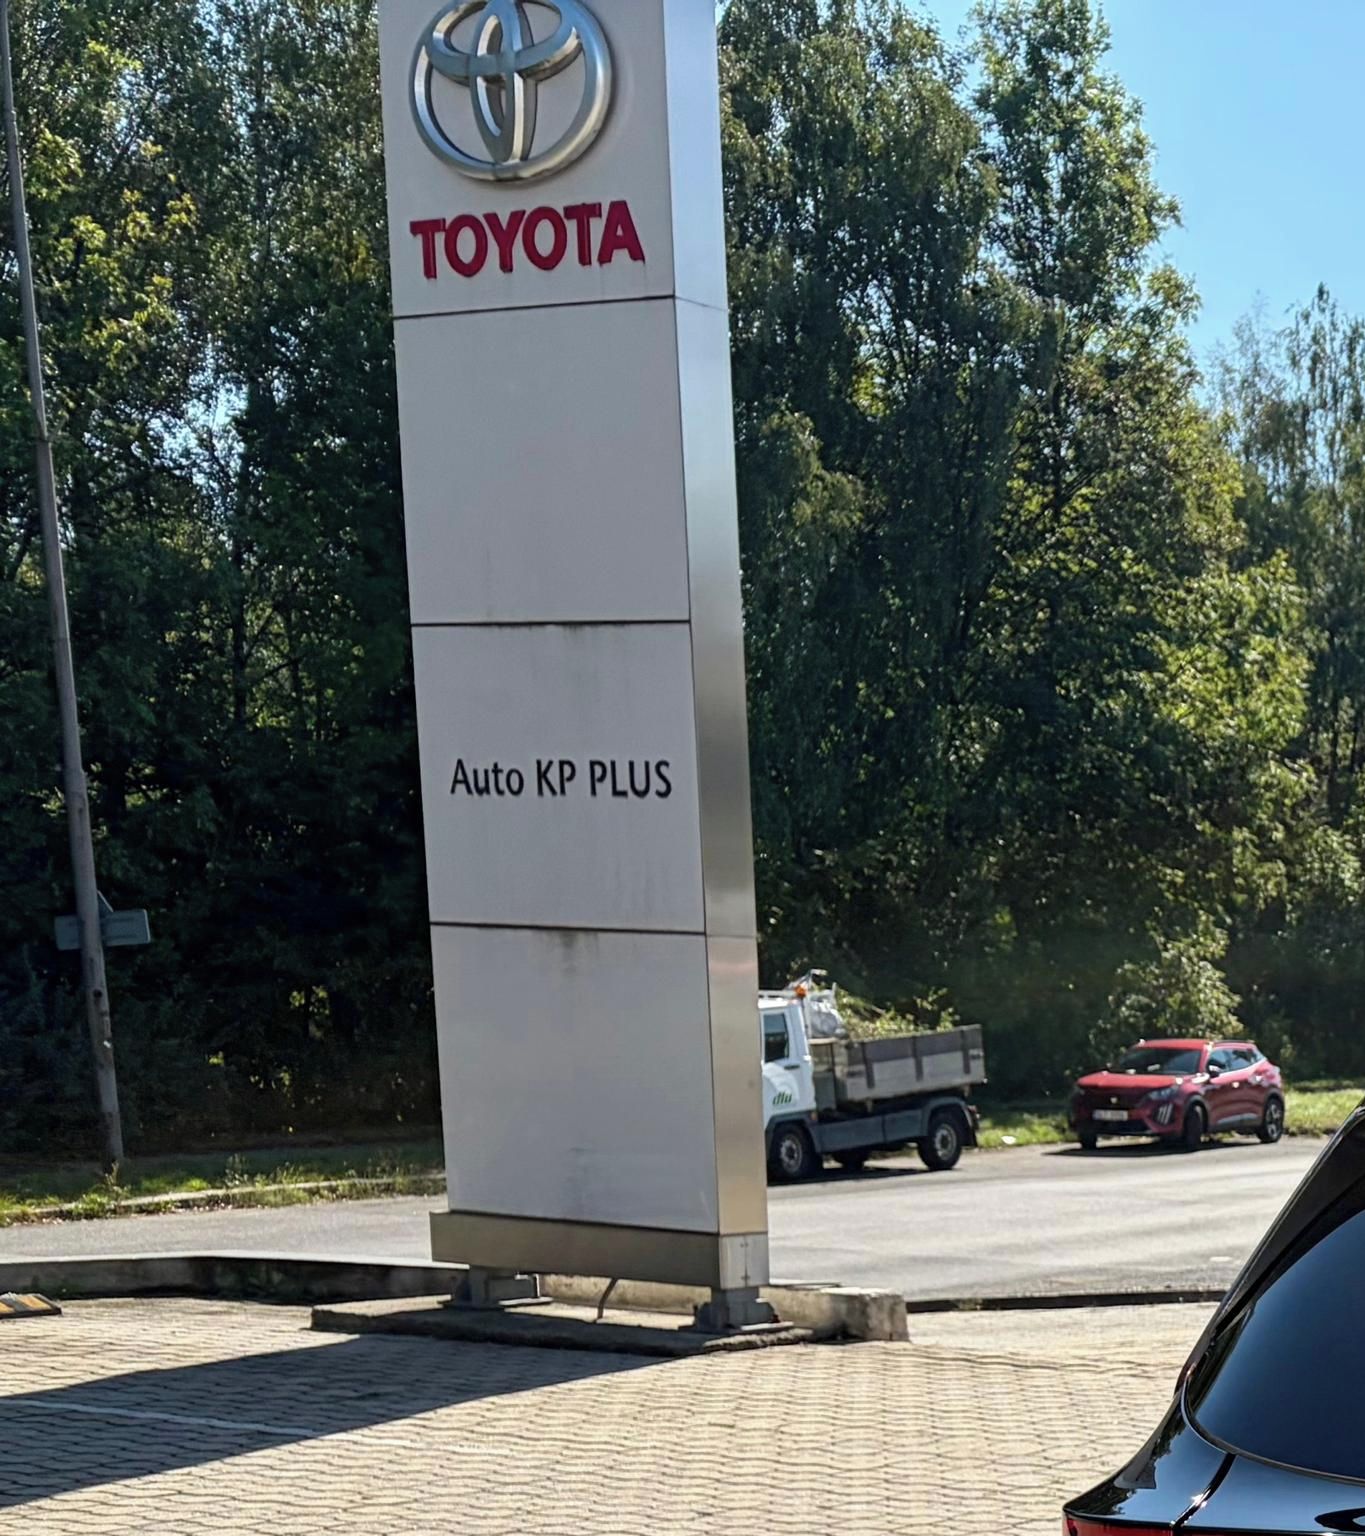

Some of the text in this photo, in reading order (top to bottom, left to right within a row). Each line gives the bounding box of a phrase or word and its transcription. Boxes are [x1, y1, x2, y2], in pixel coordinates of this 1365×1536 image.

[409, 200, 646, 280] TOYOTA
[450, 758, 673, 799] Auto KP PLUS
